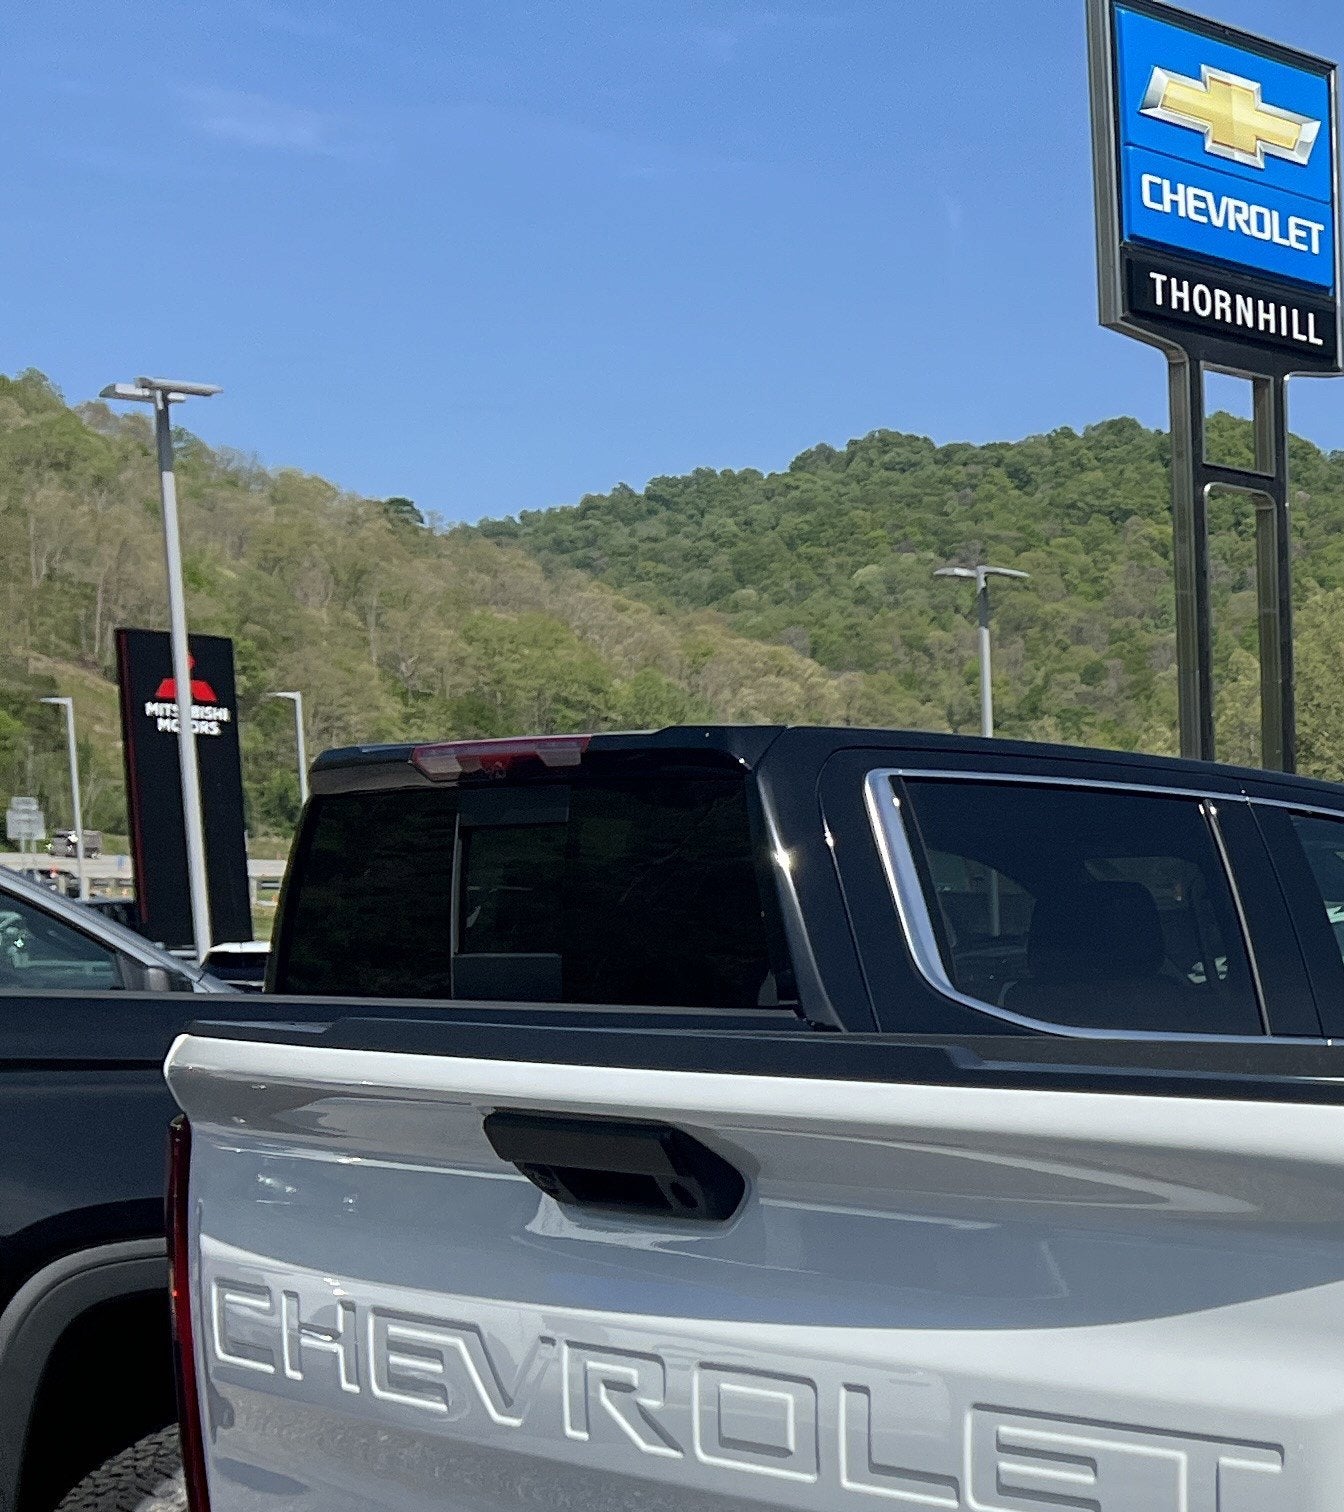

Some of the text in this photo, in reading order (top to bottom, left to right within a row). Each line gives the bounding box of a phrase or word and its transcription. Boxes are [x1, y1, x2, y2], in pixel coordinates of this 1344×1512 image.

[1141, 173, 1325, 255] CHEVROLET
[1149, 271, 1324, 346] THORNHILL
[144, 701, 232, 722] MITSBISHI
[156, 717, 222, 736] MOORS
